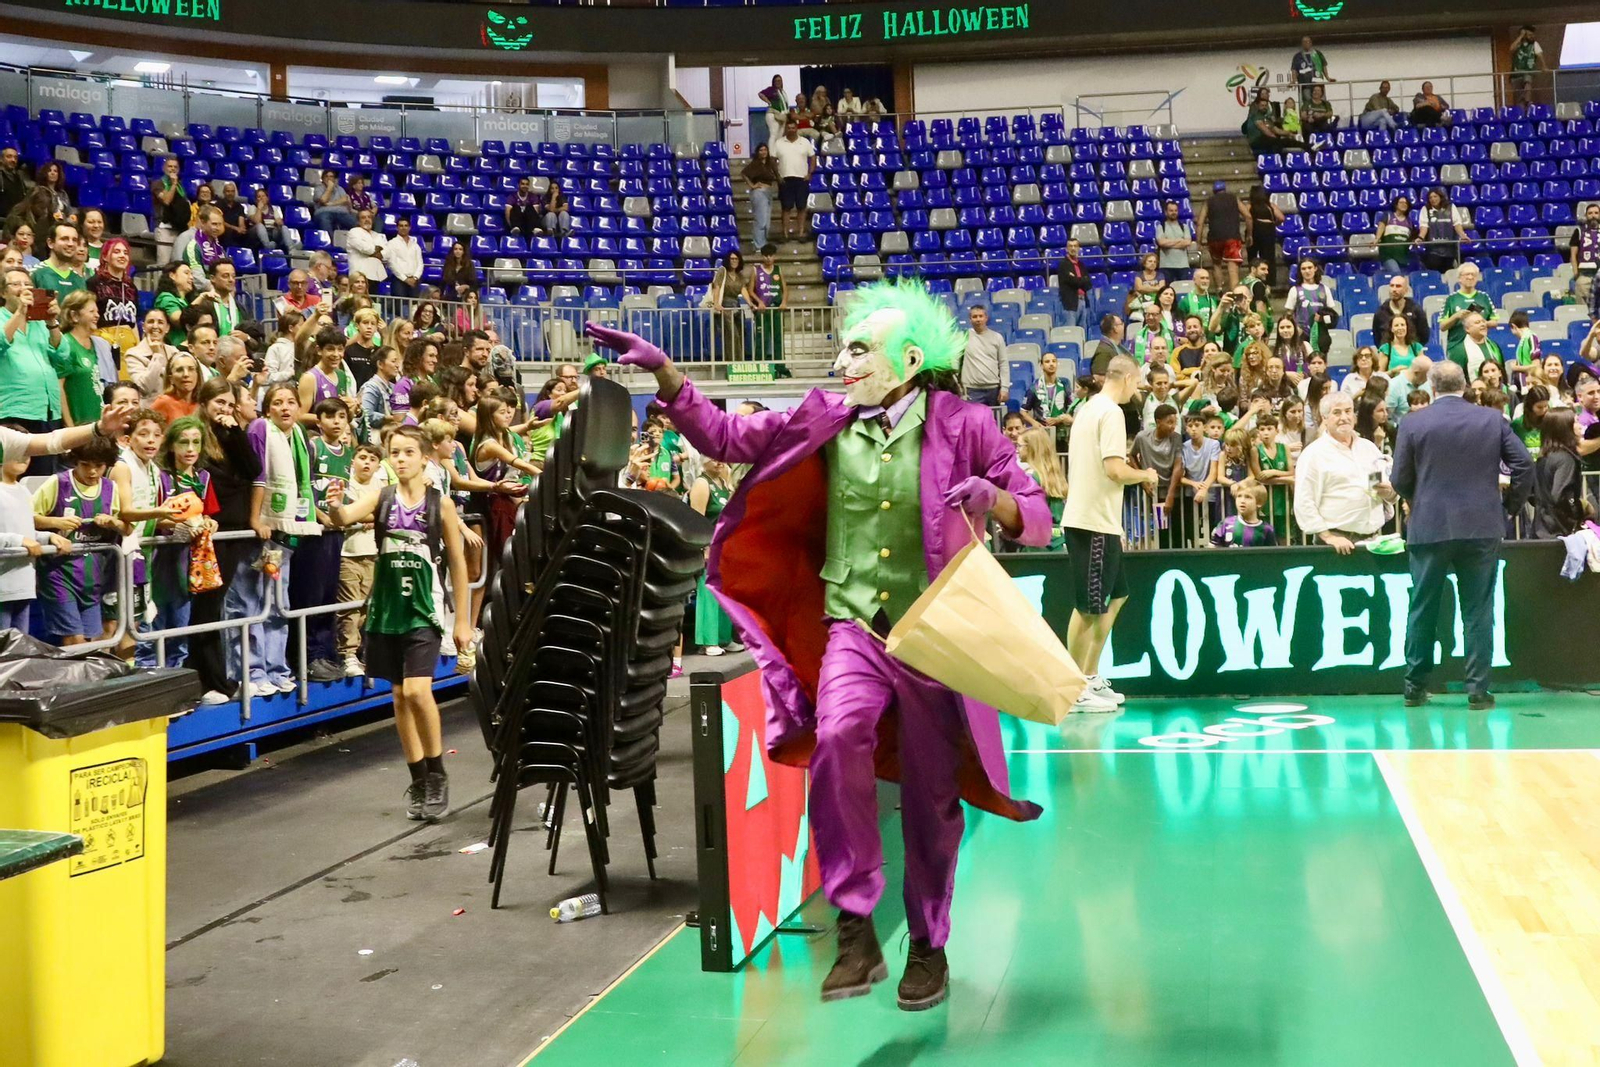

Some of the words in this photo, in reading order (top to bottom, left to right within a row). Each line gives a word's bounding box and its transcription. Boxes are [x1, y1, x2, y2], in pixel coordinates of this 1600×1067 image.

[794, 14, 862, 40] FELIZ
[883, 4, 1029, 39] HALLOWEEN
[359, 115, 385, 123] Ciudad
[732, 363, 758, 373] SALIDA
[760, 363, 770, 373] DE
[729, 374, 773, 382] EMERGENCIA
[401, 576, 413, 597] 5
[86, 770, 131, 789] ¡RECICLA!
